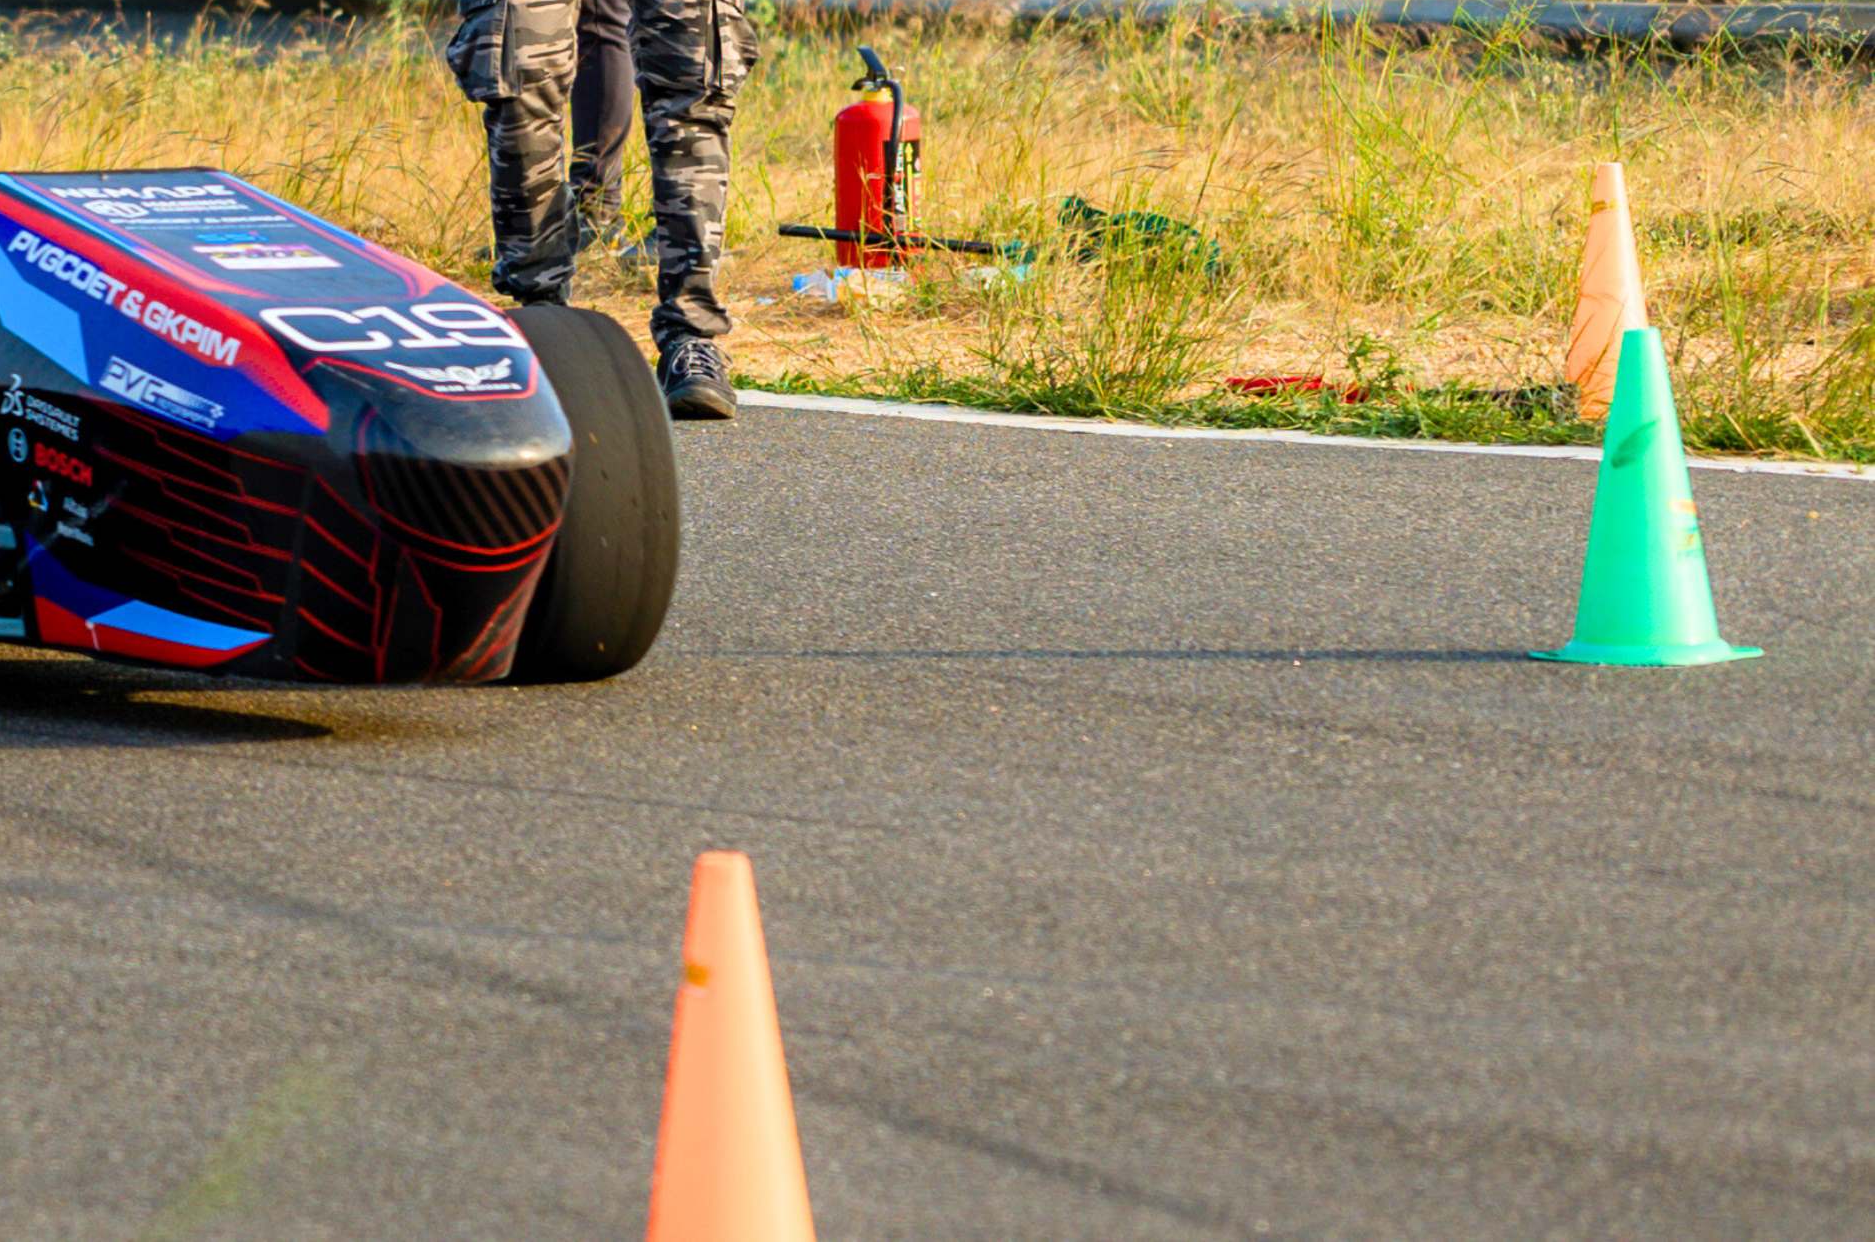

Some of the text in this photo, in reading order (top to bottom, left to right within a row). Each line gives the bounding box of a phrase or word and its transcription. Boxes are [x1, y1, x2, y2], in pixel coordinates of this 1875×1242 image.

[8, 230, 242, 366] PVGCOET & GKPIM
[259, 302, 529, 352] C19
[34, 441, 94, 487] BOSCH
